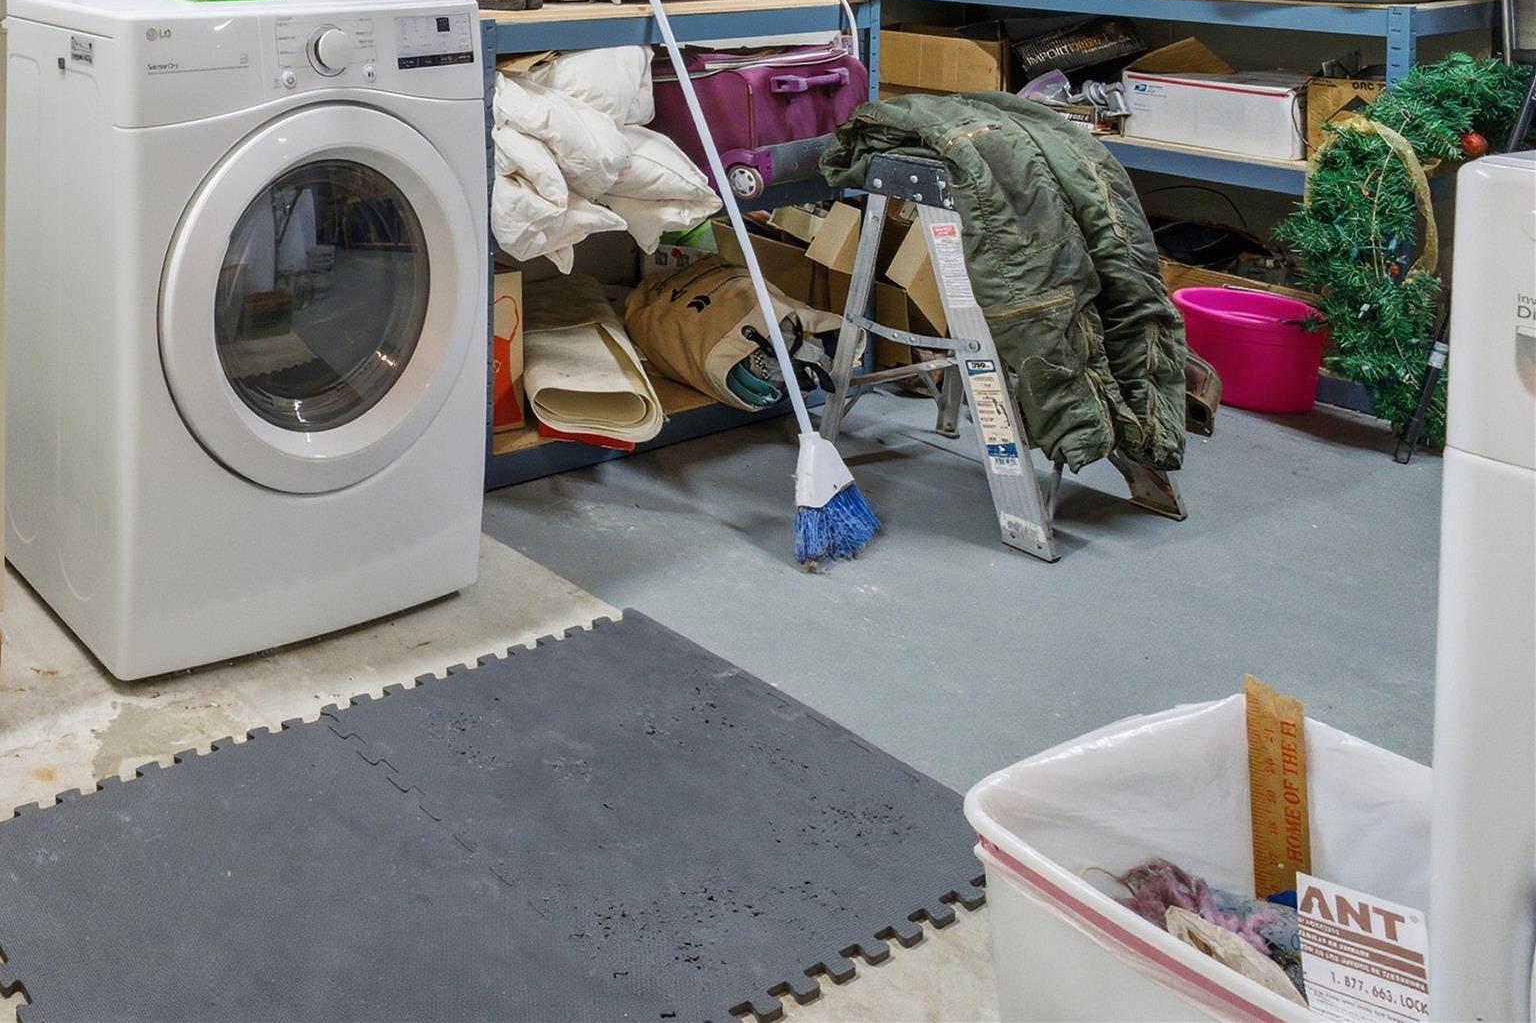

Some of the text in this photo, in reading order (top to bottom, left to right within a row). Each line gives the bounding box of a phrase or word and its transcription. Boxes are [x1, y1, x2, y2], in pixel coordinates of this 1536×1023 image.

[1027, 44, 1069, 66] IMPORT
[1280, 741, 1299, 778] THE
[1283, 778, 1301, 805] OF
[1284, 806, 1304, 863] HOME
